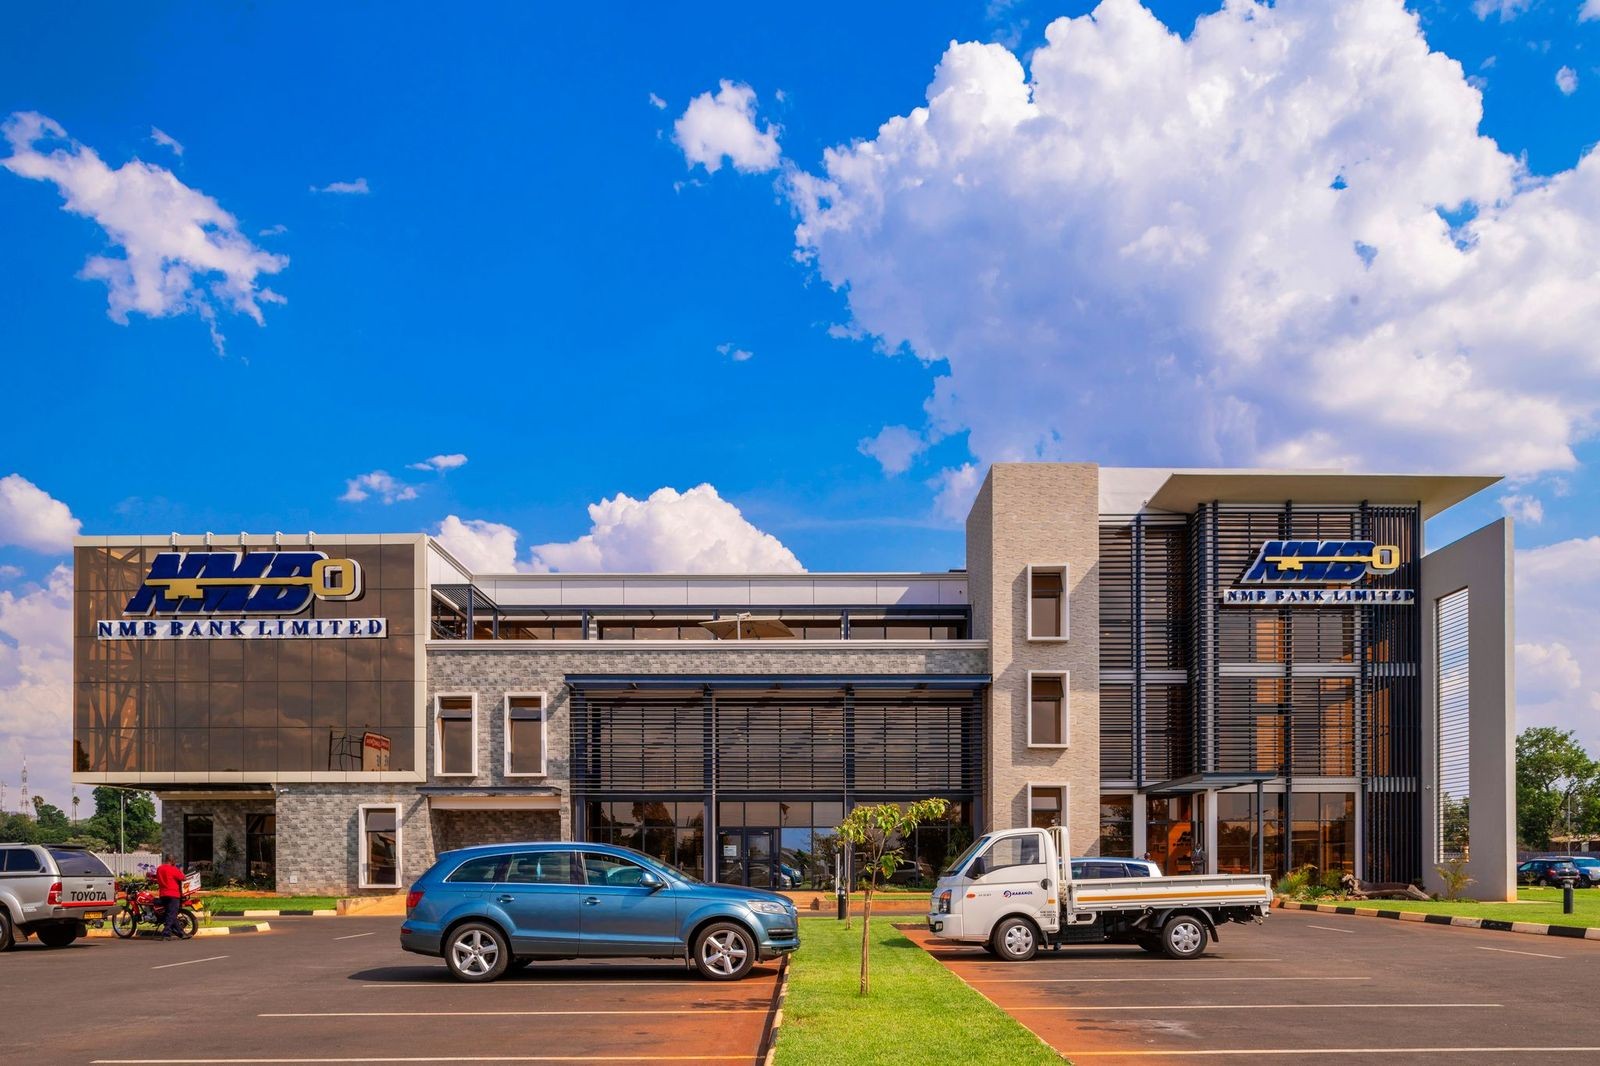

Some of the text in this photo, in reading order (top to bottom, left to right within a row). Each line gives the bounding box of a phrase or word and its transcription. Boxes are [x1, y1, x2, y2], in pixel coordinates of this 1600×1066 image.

[1227, 590, 1414, 602] NMB BANK LIMITED
[99, 619, 383, 637] NMB BANK LIMITED
[70, 891, 107, 901] TOYOTA
